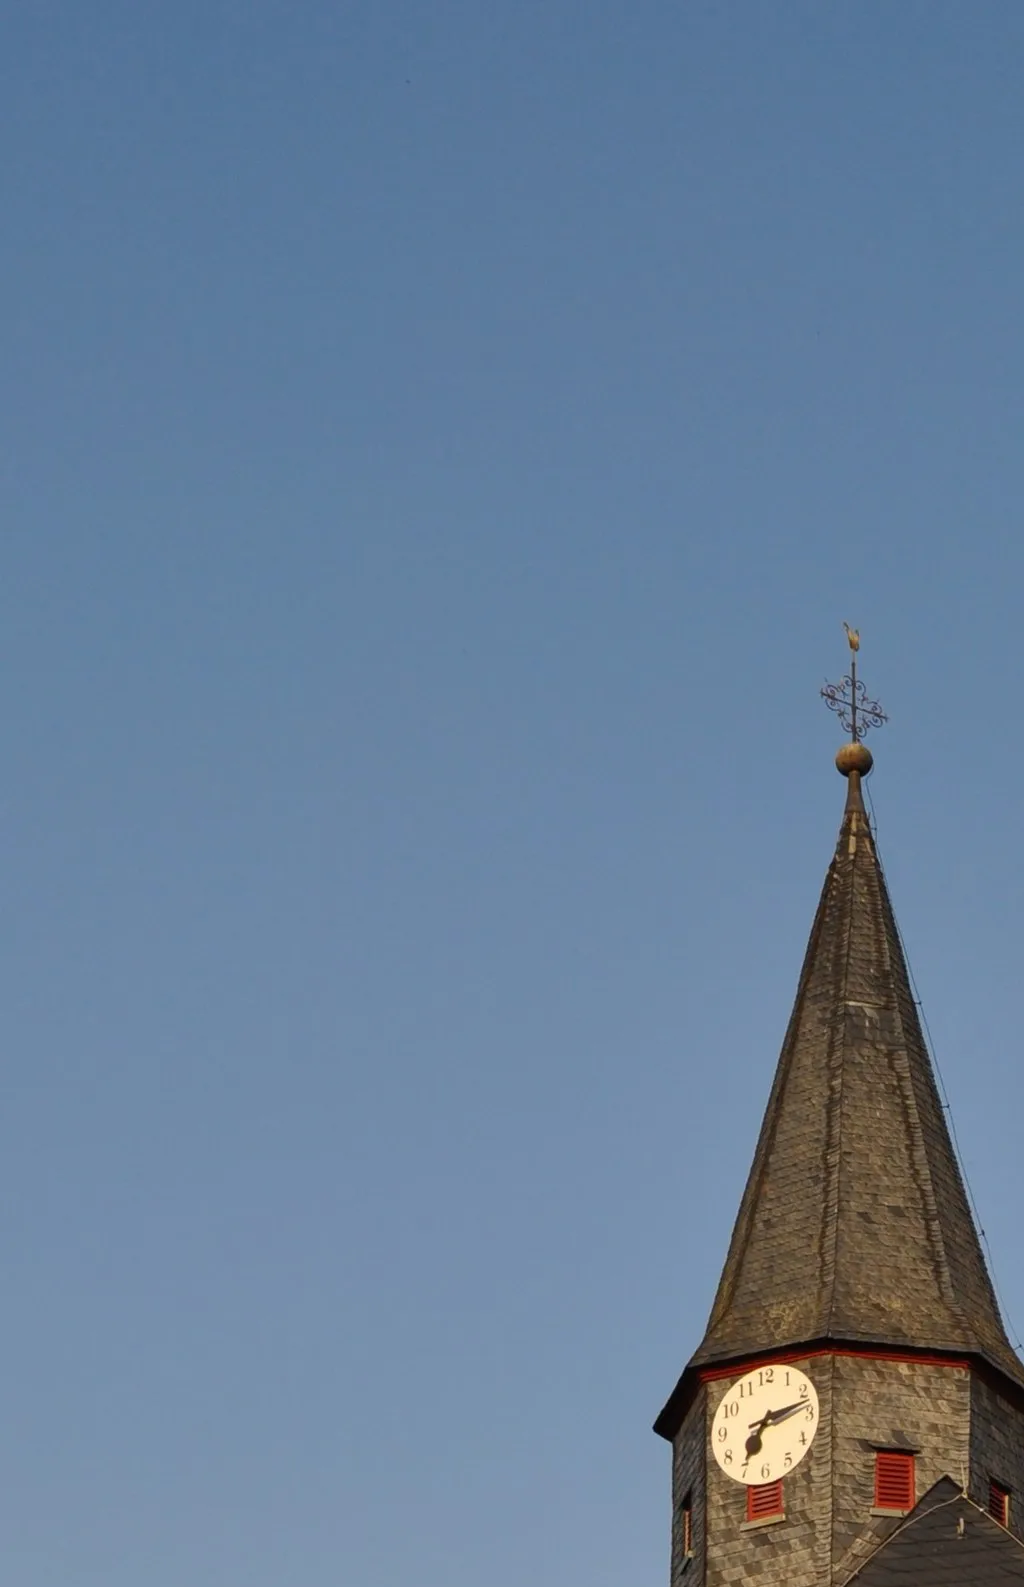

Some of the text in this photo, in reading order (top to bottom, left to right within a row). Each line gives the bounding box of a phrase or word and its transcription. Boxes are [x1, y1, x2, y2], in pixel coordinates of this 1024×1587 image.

[758, 1368, 774, 1387] 12
[785, 1371, 791, 1387] 1
[739, 1382, 753, 1398] 11
[799, 1384, 809, 1399] 2
[722, 1402, 739, 1419] 10
[805, 1405, 814, 1421] 3
[718, 1427, 728, 1443] 9
[799, 1431, 807, 1446] 4
[724, 1449, 733, 1465] 8
[784, 1452, 793, 1468] 5
[741, 1462, 749, 1479] 7
[761, 1463, 770, 1479] 6
